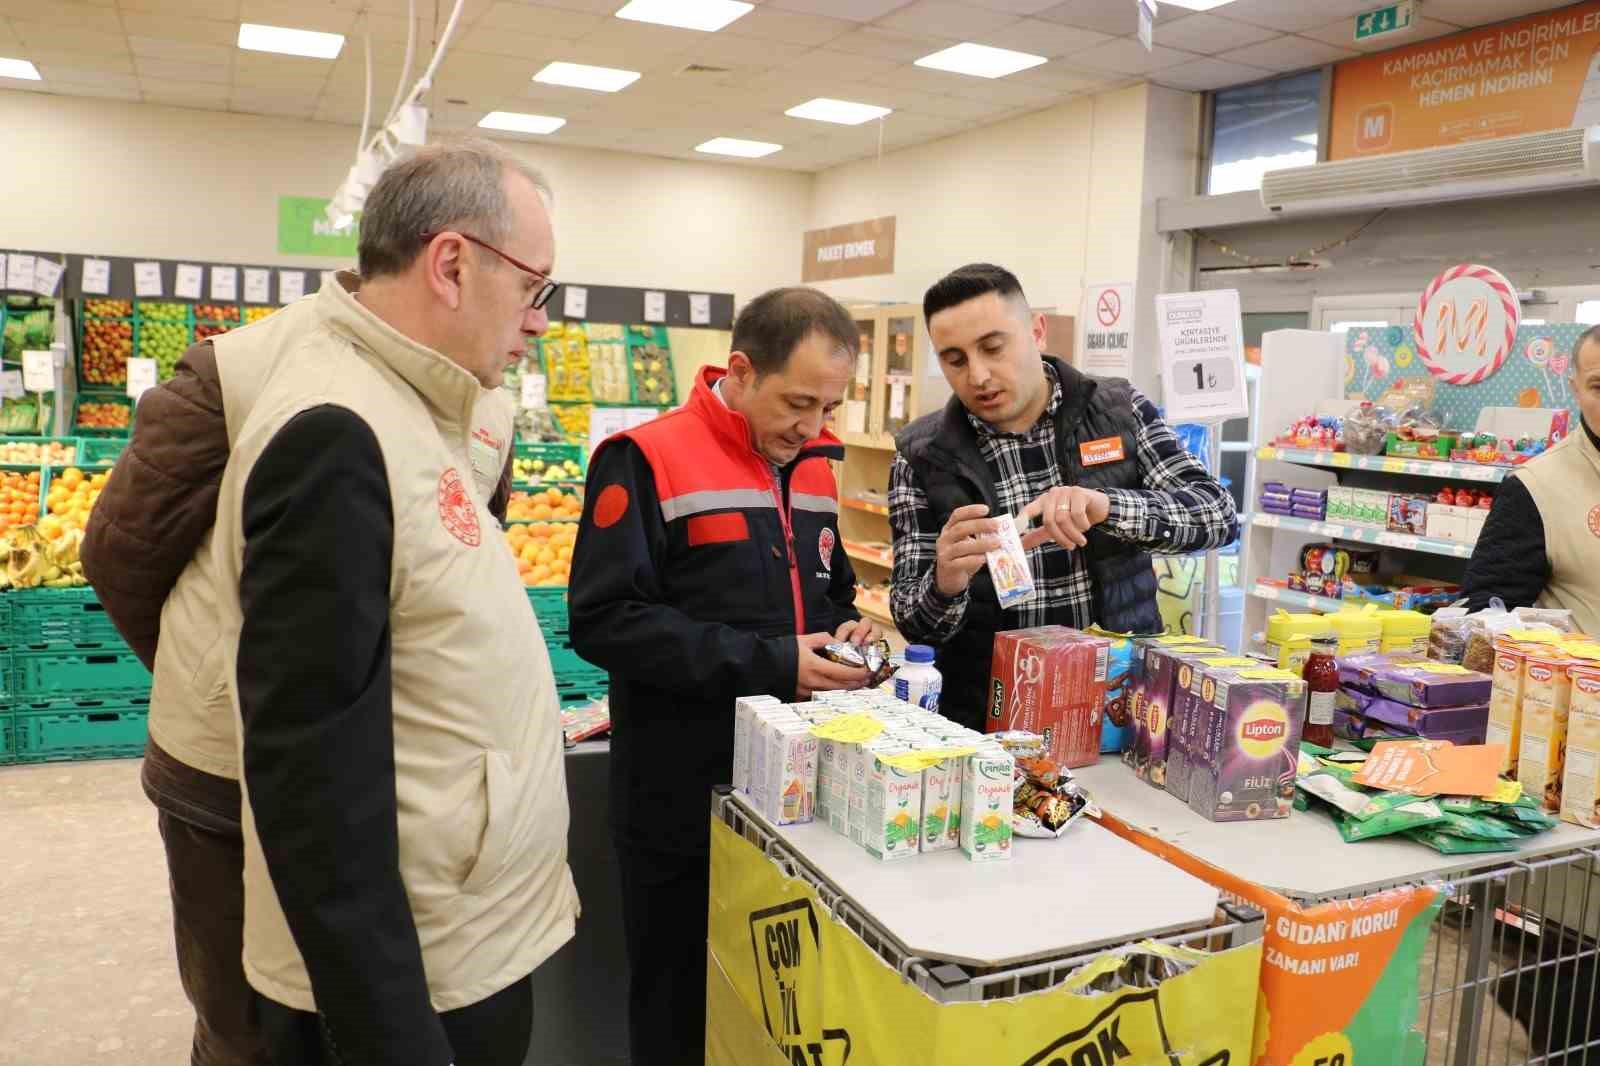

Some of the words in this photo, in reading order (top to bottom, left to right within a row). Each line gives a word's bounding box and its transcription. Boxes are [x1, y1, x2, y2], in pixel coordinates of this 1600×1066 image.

[1383, 43, 1467, 76] KAMPANYA
[1472, 38, 1495, 57] VE
[1410, 53, 1524, 89] KAÇIRMAMAK
[1530, 42, 1569, 69] İÇİN
[1419, 84, 1475, 109] HEMEN
[1479, 68, 1553, 97] İNDİRİN!
[1363, 115, 1385, 139] M
[1192, 363, 1204, 390] 1
[1246, 720, 1281, 736] Lipton
[888, 782, 919, 795] Organic
[977, 783, 1011, 796] Organic
[1244, 776, 1272, 788] FİLİZ
[1351, 909, 1399, 938] KORU!
[765, 918, 801, 980] ÇOK
[1266, 947, 1327, 975] ZAMANI
[1330, 951, 1360, 972] VAR!
